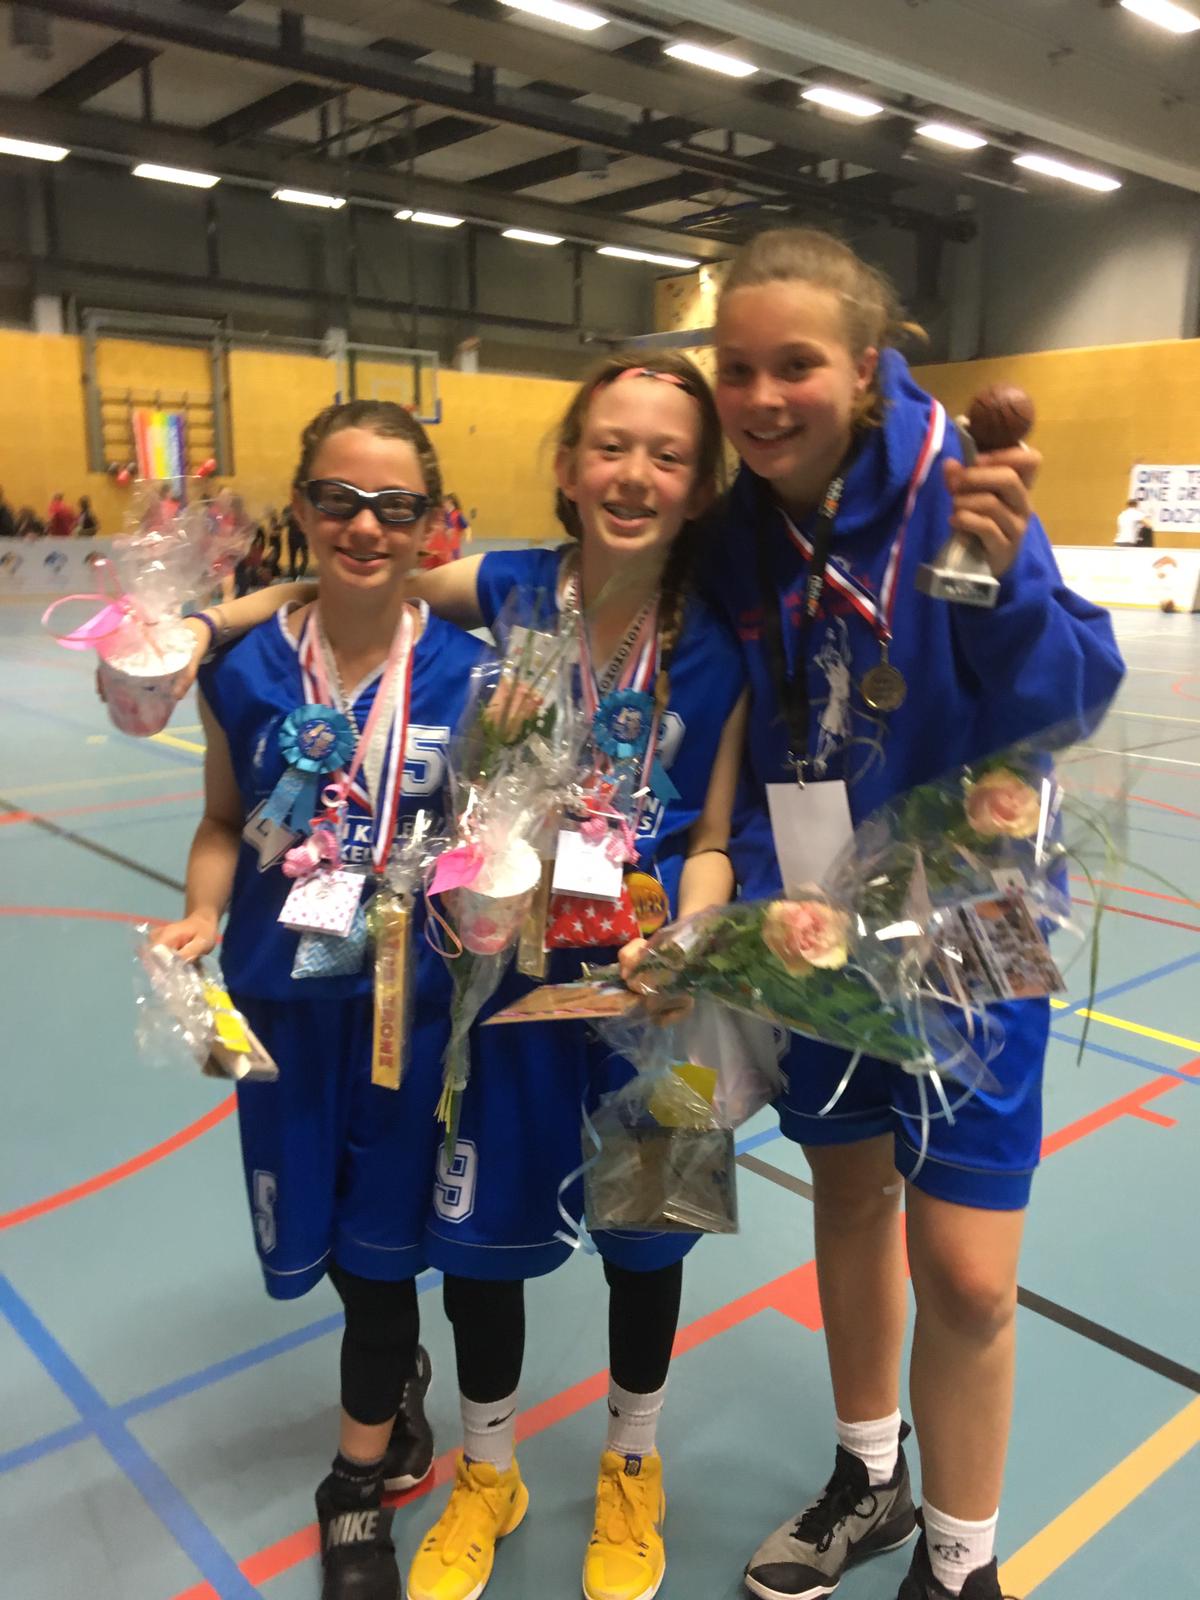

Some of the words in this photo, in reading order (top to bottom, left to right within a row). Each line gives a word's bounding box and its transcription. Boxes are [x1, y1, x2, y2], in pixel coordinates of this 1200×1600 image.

[1135, 486, 1169, 501] ONE
[1137, 470, 1170, 485] ONE
[400, 724, 451, 797] 5
[433, 1138, 478, 1224] 9
[326, 1510, 379, 1548] NIKE
